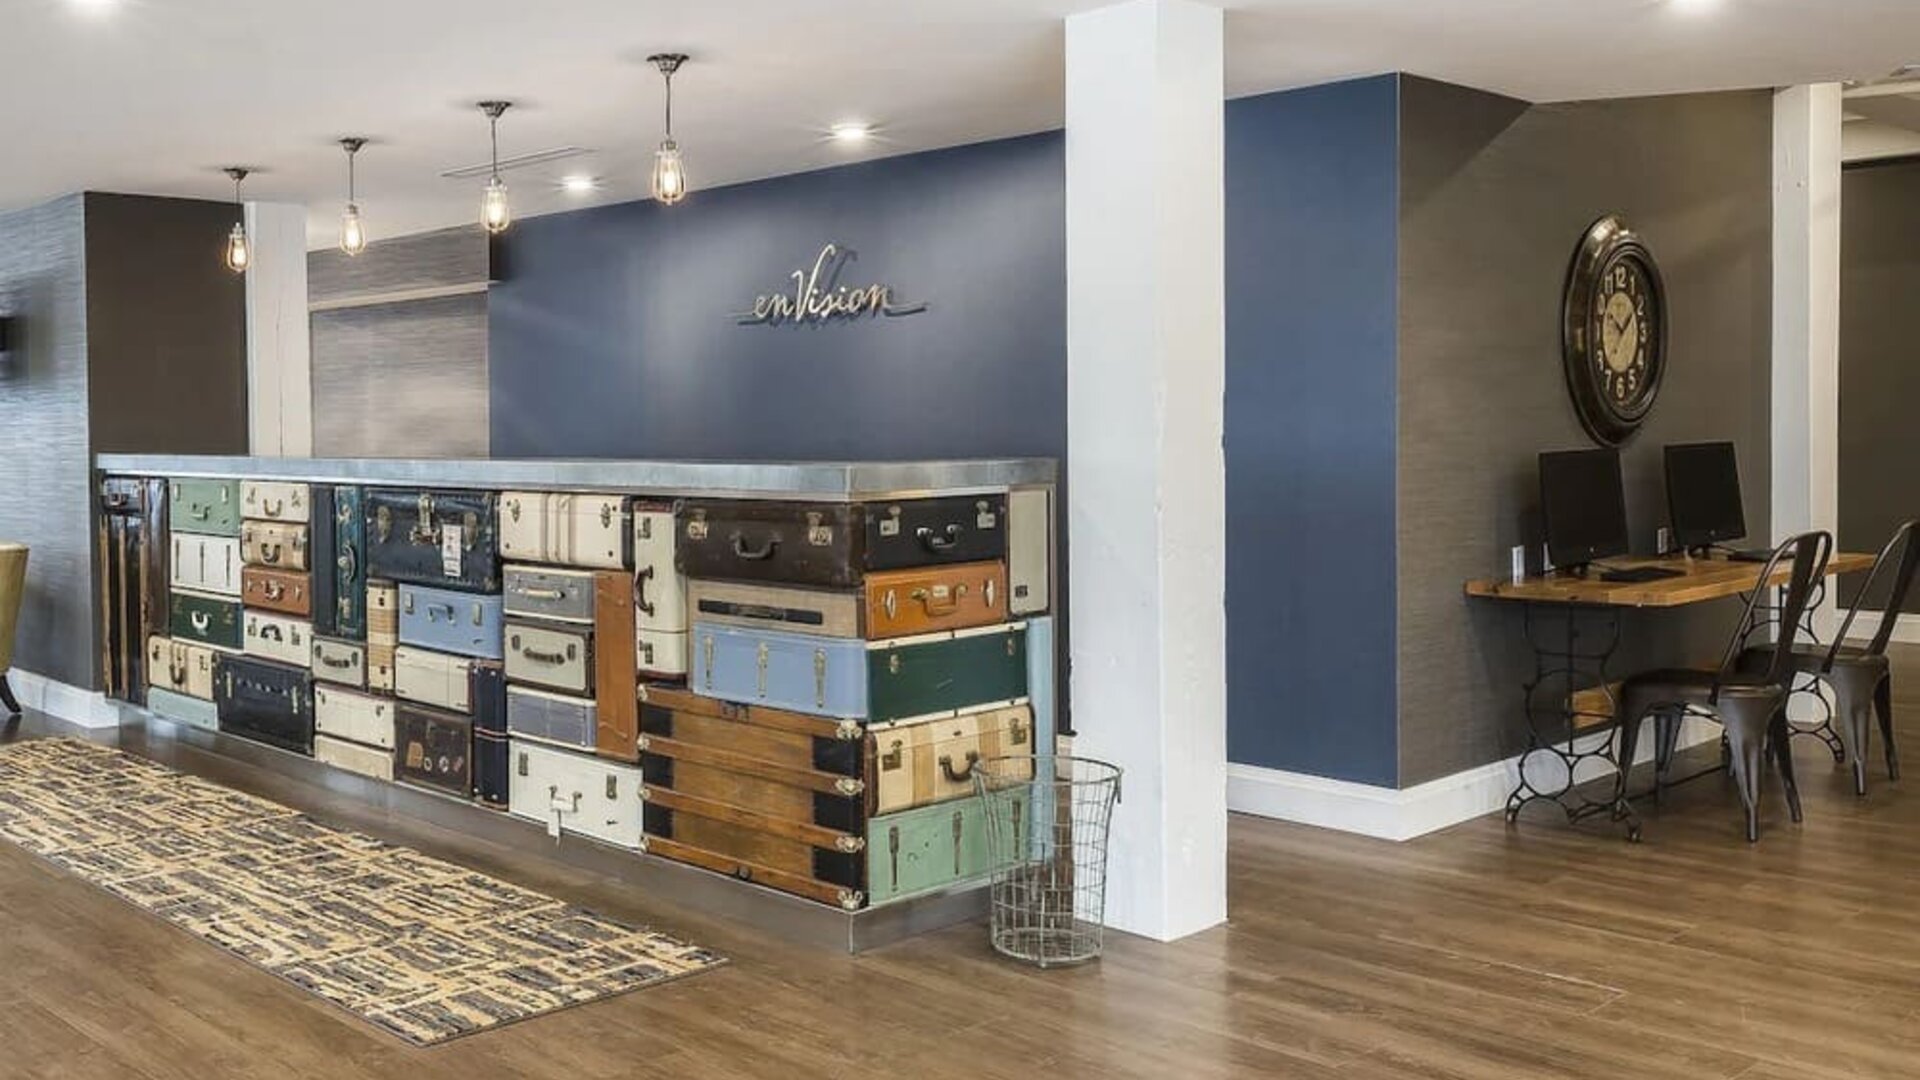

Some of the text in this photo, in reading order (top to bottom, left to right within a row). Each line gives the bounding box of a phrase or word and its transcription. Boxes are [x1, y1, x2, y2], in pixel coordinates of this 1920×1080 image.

[736, 243, 928, 322] enVision
[1615, 266, 1627, 288] 12
[1630, 275, 1635, 295] 1
[1637, 294, 1645, 315] 2
[1639, 321, 1647, 343] 3
[1636, 348, 1644, 368] 4
[1604, 369, 1612, 392] 7
[1616, 376, 1625, 399] 6
[1628, 369, 1637, 390] 5
